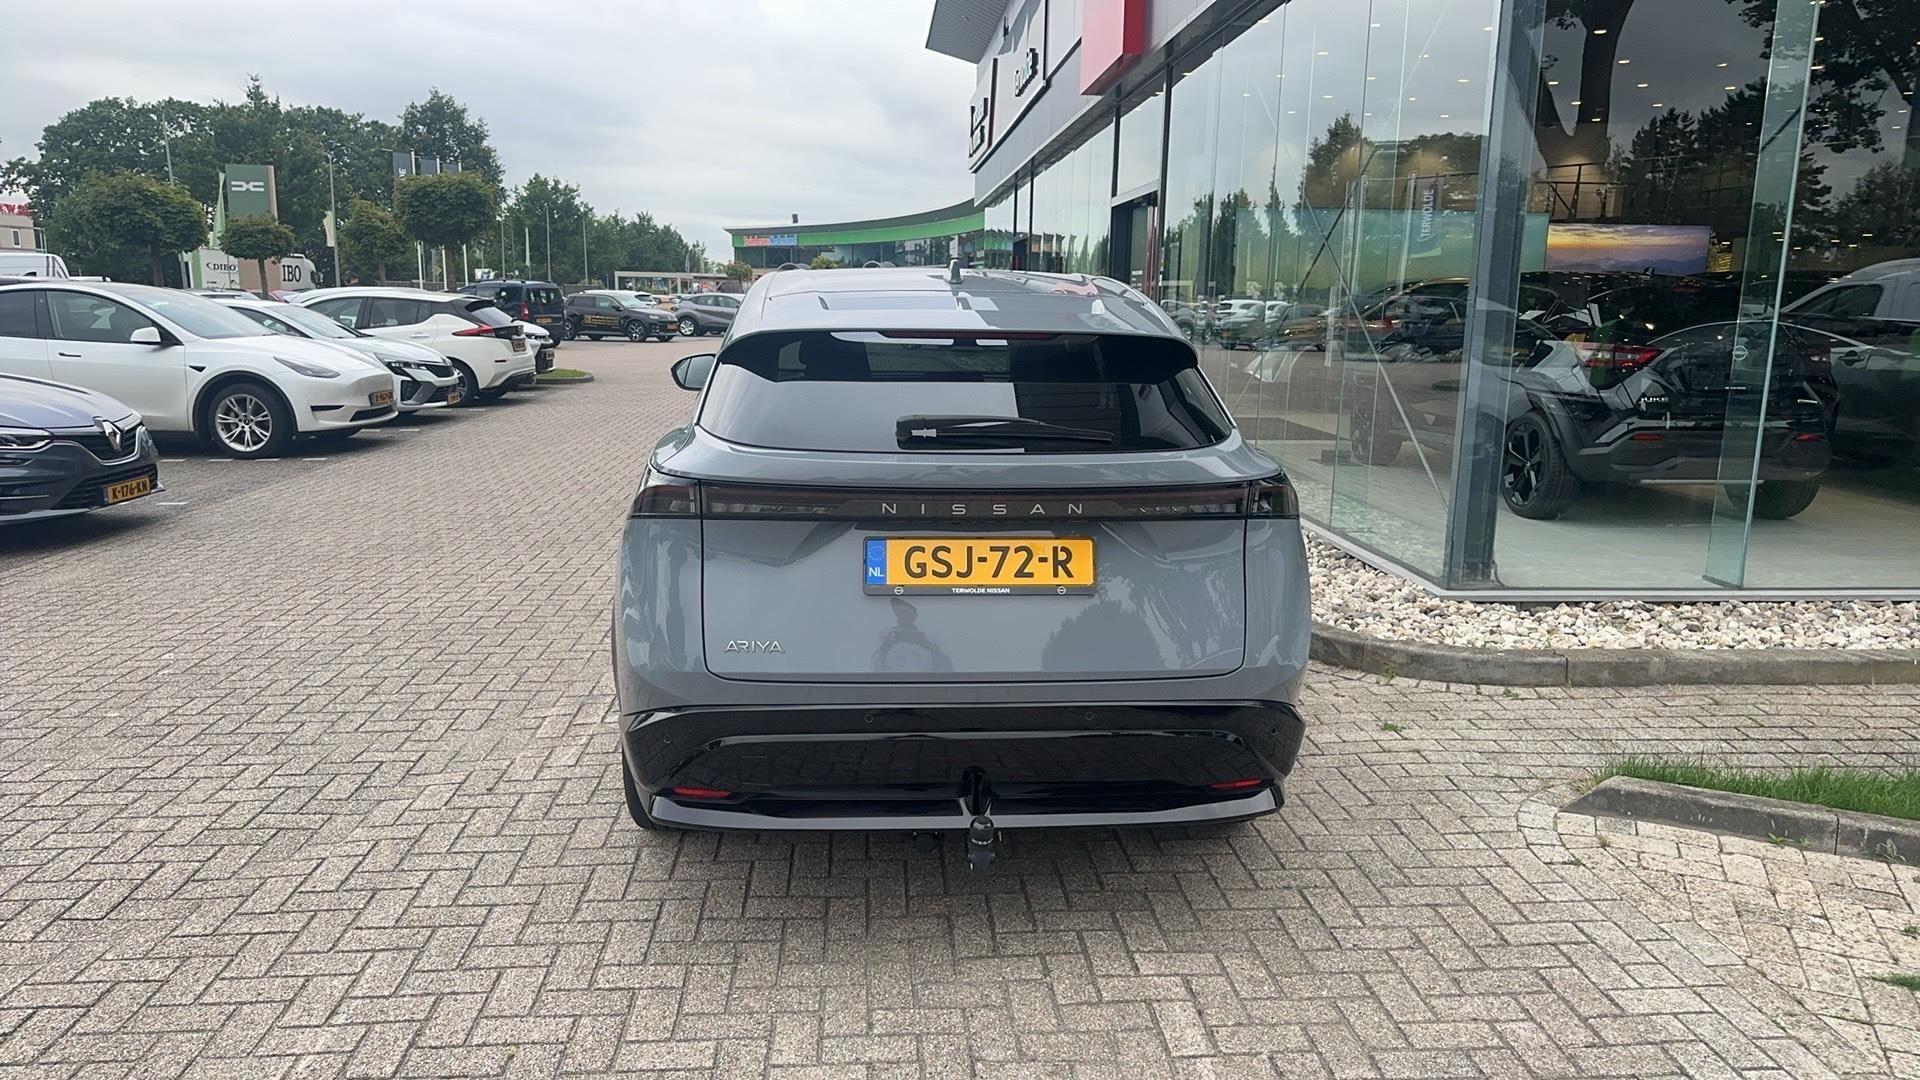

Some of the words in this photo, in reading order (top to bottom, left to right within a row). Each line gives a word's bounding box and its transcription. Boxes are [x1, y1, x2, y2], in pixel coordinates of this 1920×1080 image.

[1420, 188, 1434, 238] TERWOLDE
[111, 479, 149, 500] K-176-KN
[881, 503, 1083, 514] NISSAN
[903, 545, 1075, 579] GSJ-72-R
[868, 566, 885, 577] NL
[723, 640, 786, 653] ARIYA
